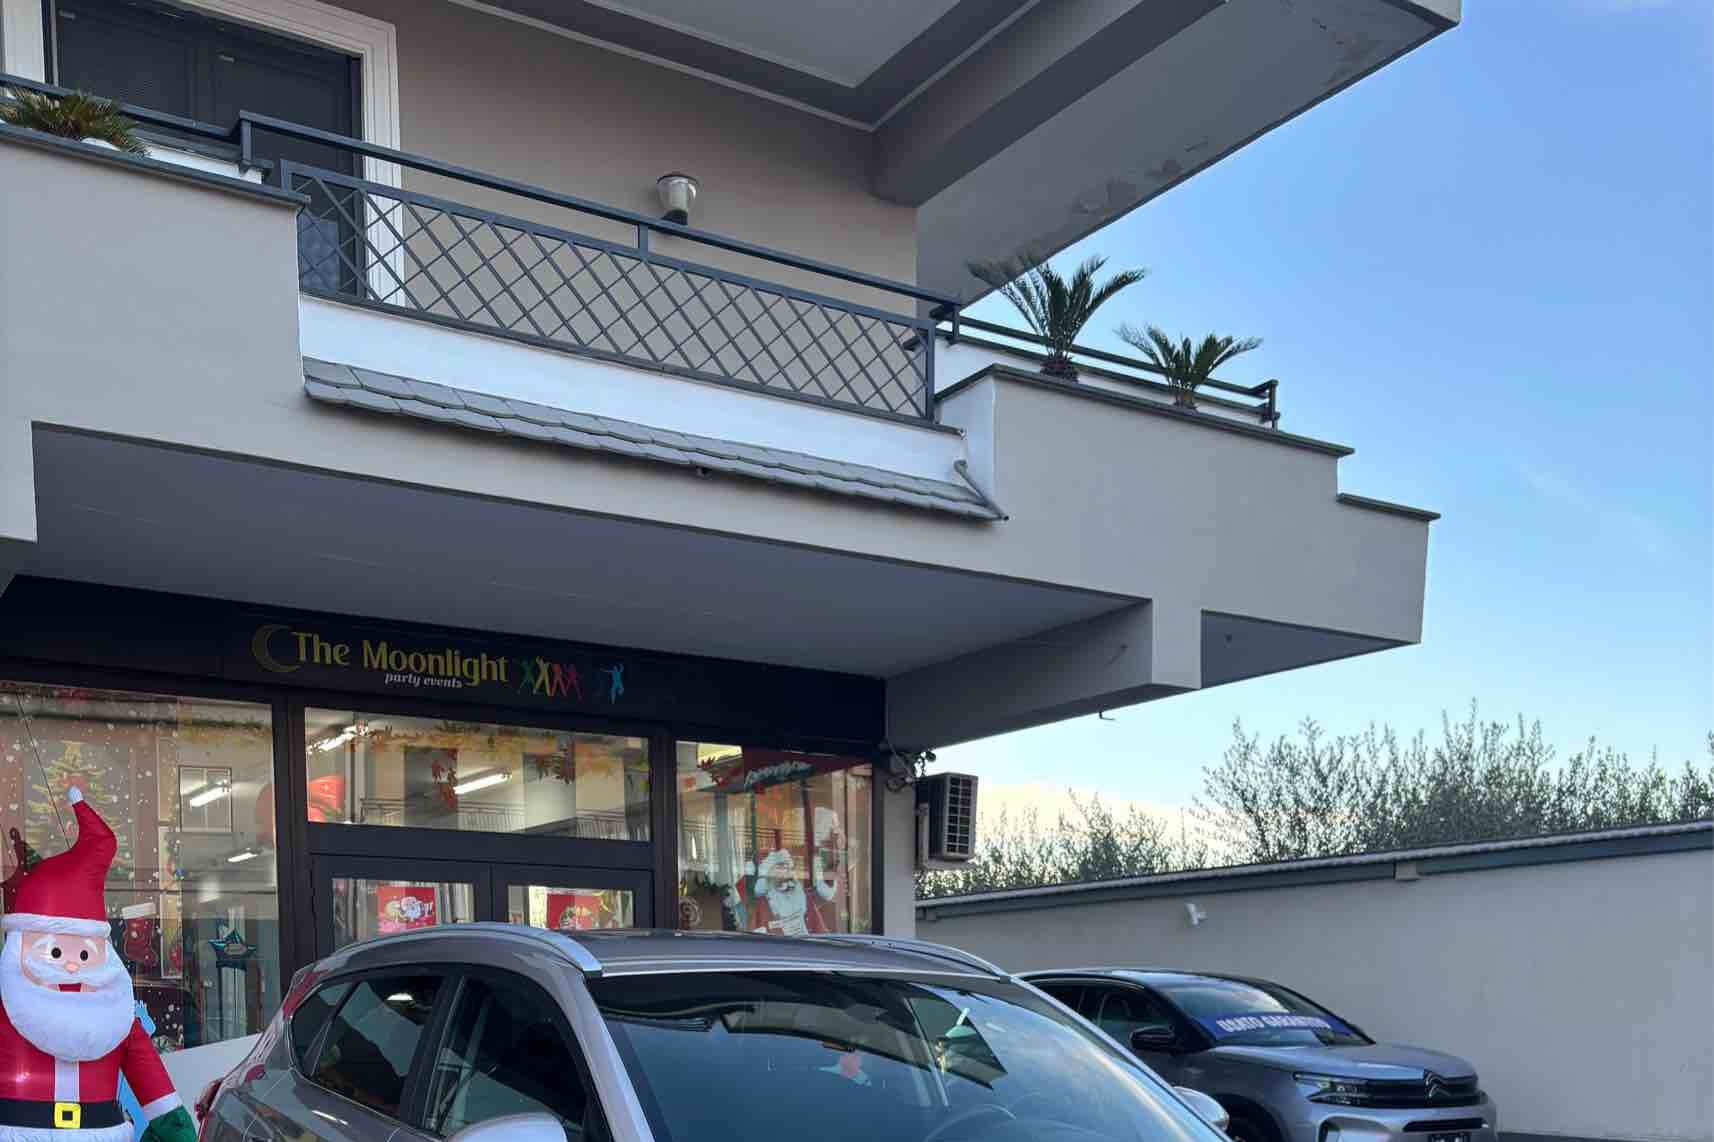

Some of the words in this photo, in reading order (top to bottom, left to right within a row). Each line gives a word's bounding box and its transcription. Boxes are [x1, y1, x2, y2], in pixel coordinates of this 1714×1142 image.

[292, 632, 350, 666] The
[362, 638, 508, 687] Moonlight
[384, 671, 422, 688] party
[423, 675, 464, 689] events
